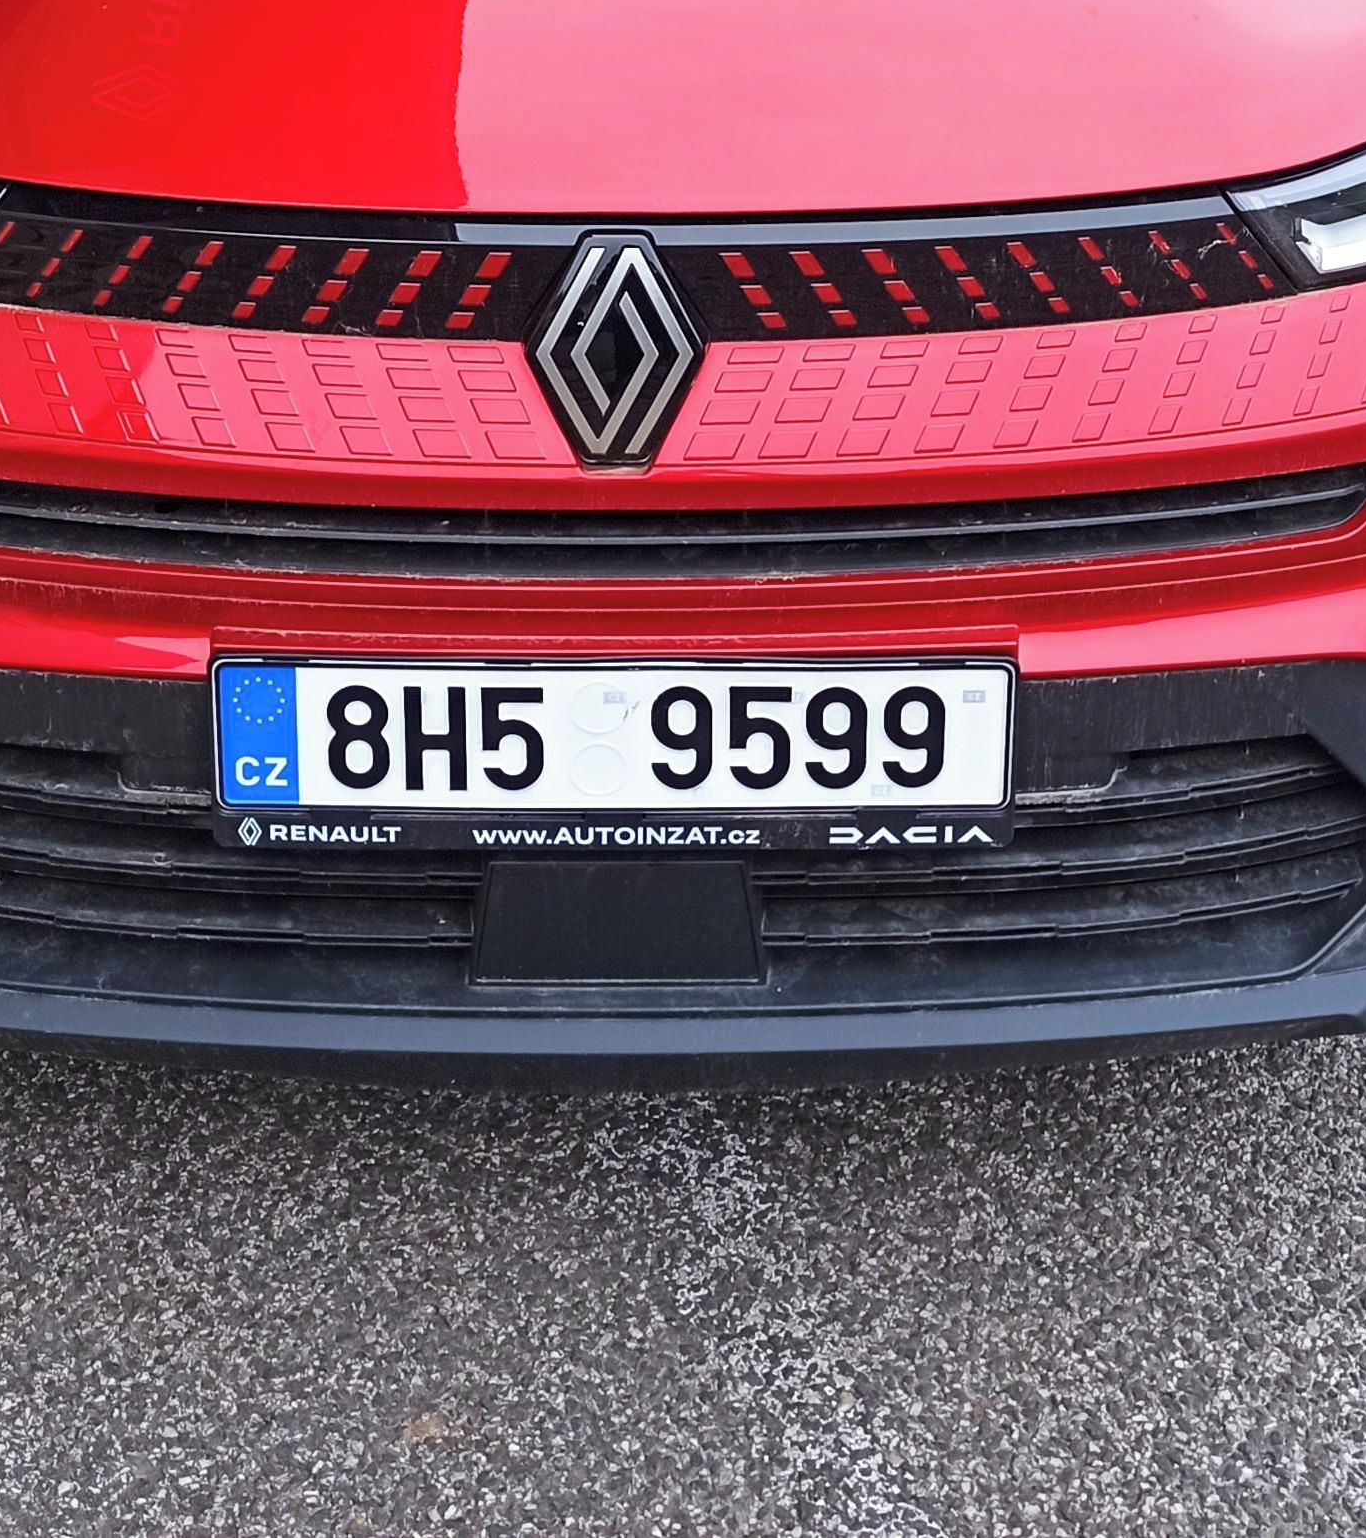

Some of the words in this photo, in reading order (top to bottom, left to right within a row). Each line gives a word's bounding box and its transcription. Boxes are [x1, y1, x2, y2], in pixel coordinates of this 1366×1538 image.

[325, 684, 544, 791] 8H5
[650, 685, 947, 790] 9599
[235, 756, 288, 787] CZ
[269, 823, 402, 844] RENAULT
[471, 826, 761, 845] www.AUTOINZAT.cz
[828, 825, 993, 844] DACIA
